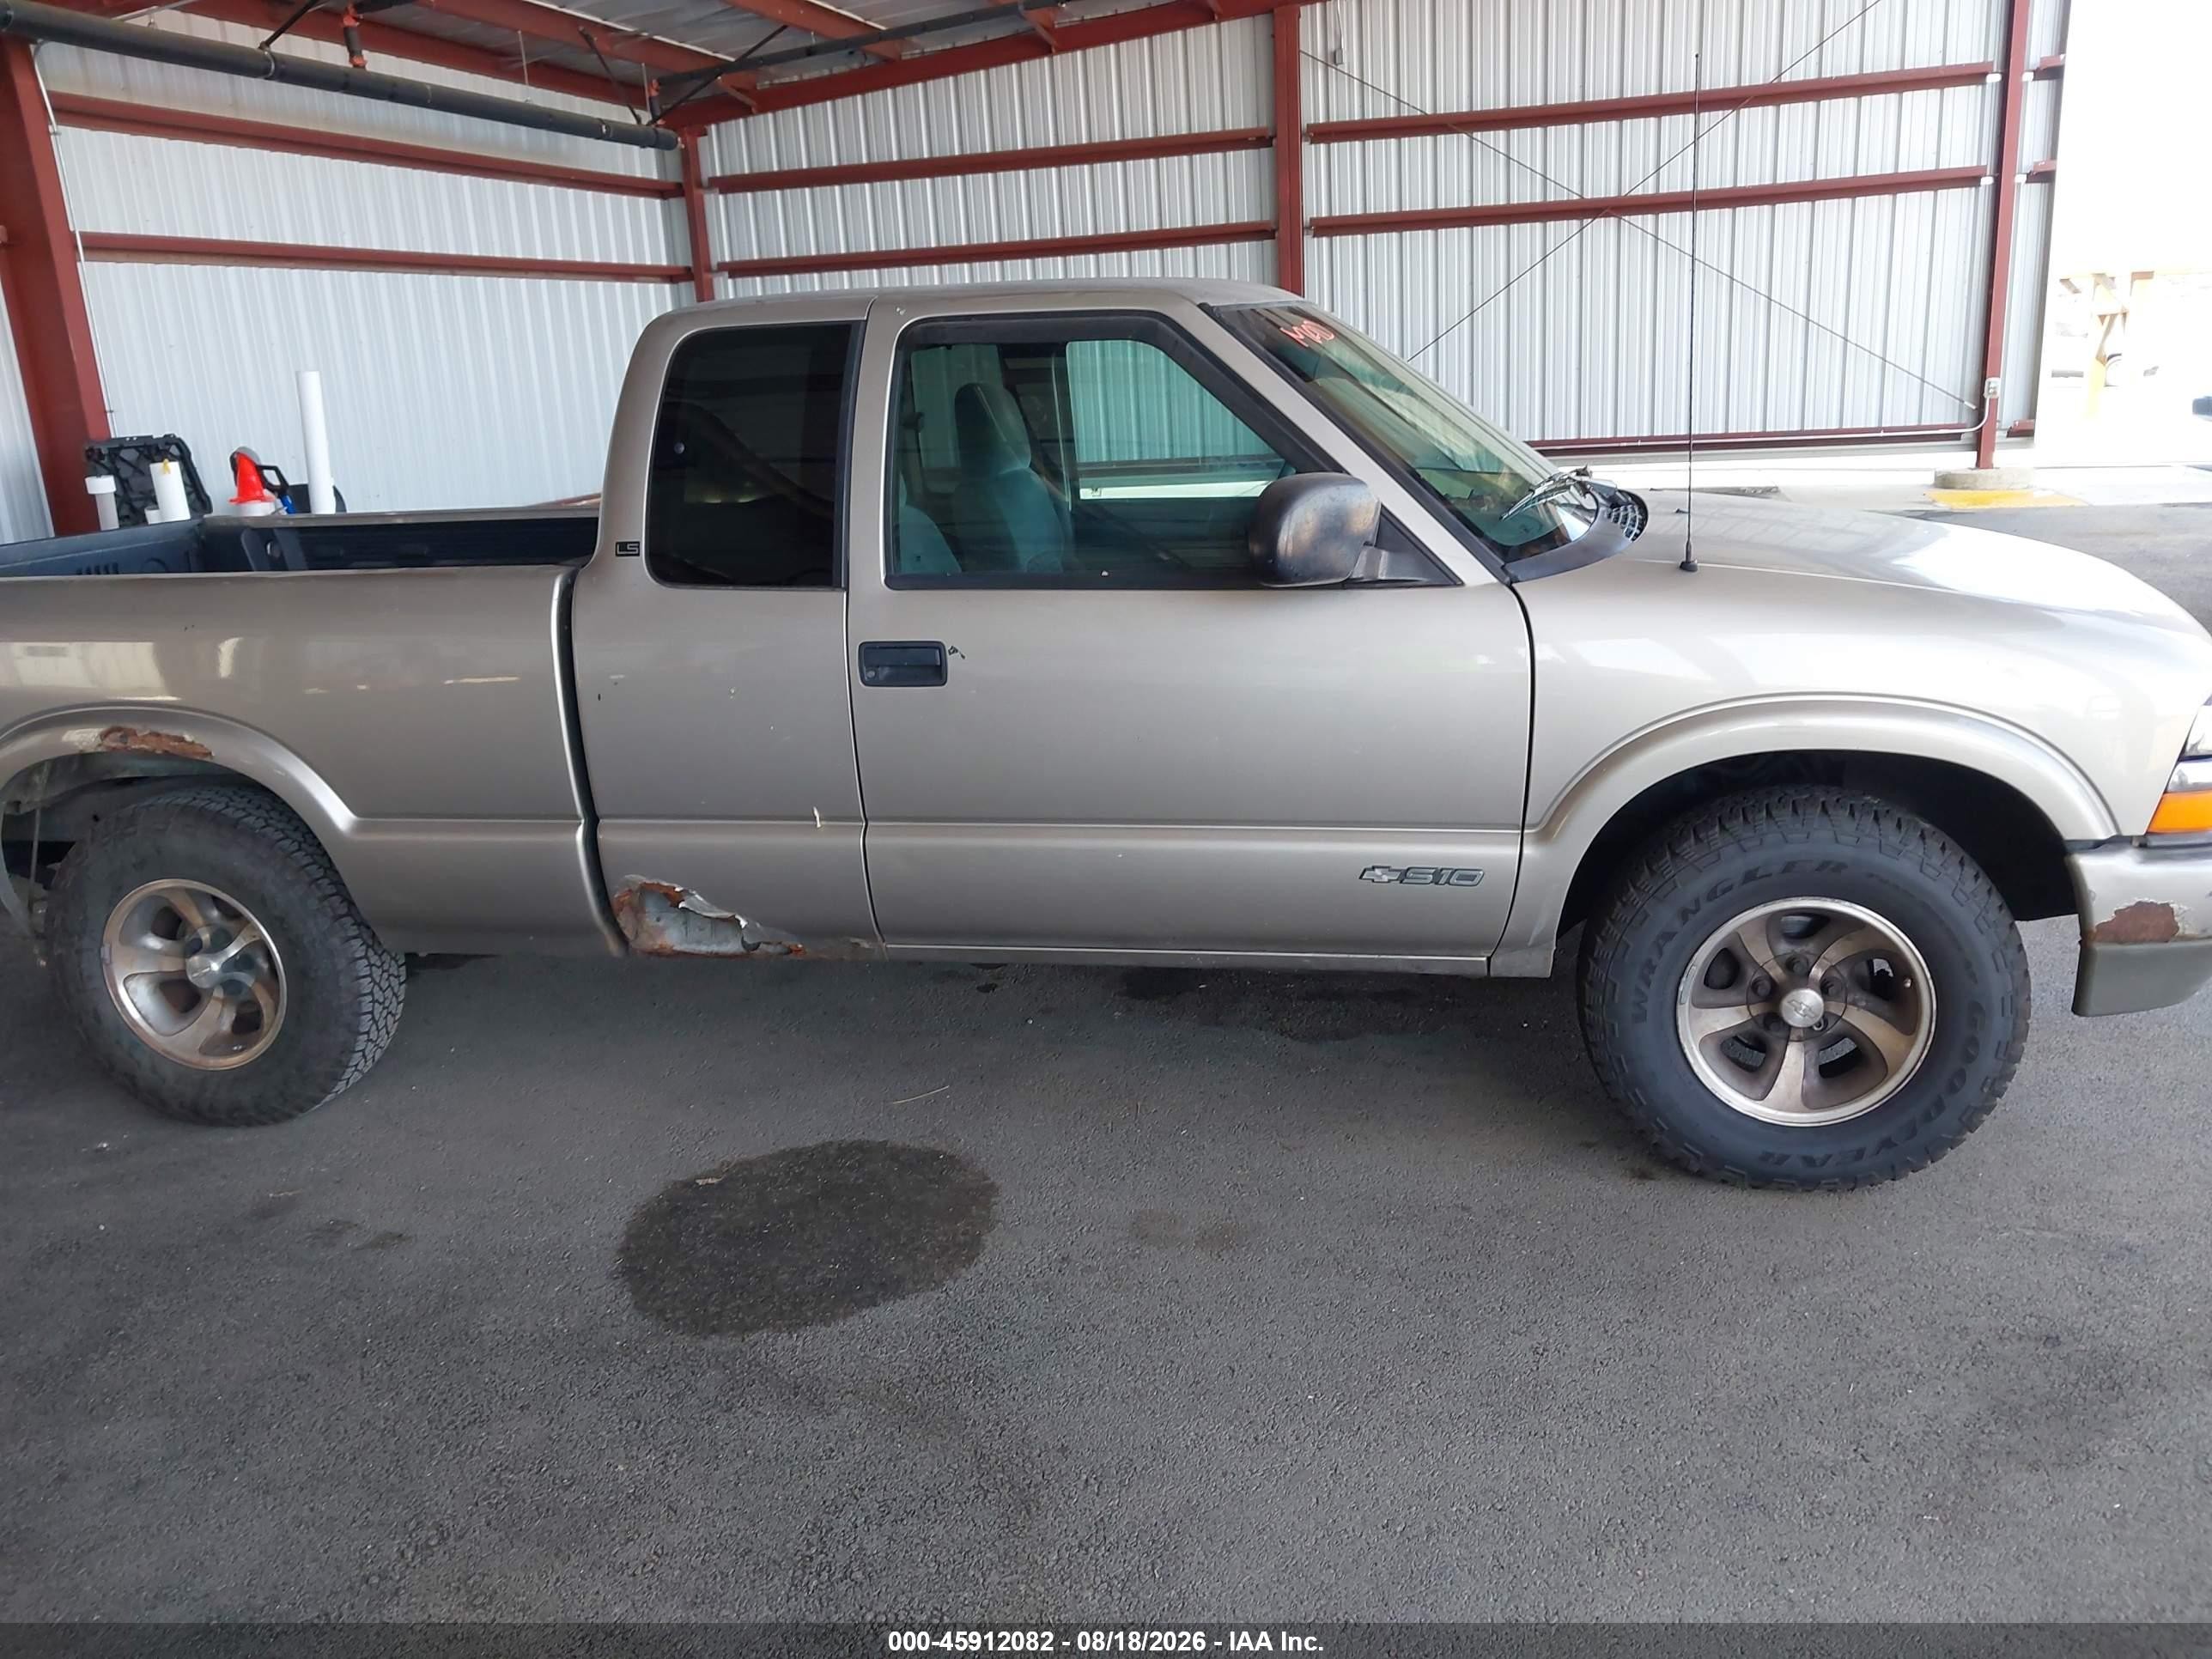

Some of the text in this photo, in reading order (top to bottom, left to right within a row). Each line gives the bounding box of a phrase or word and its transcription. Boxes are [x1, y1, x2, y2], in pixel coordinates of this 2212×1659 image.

[617, 543, 639, 555] LS
[1400, 866, 1485, 887] S10
[1632, 860, 1850, 1024] WRANGLER
[1757, 1000, 1986, 1168] GOODYEAR
